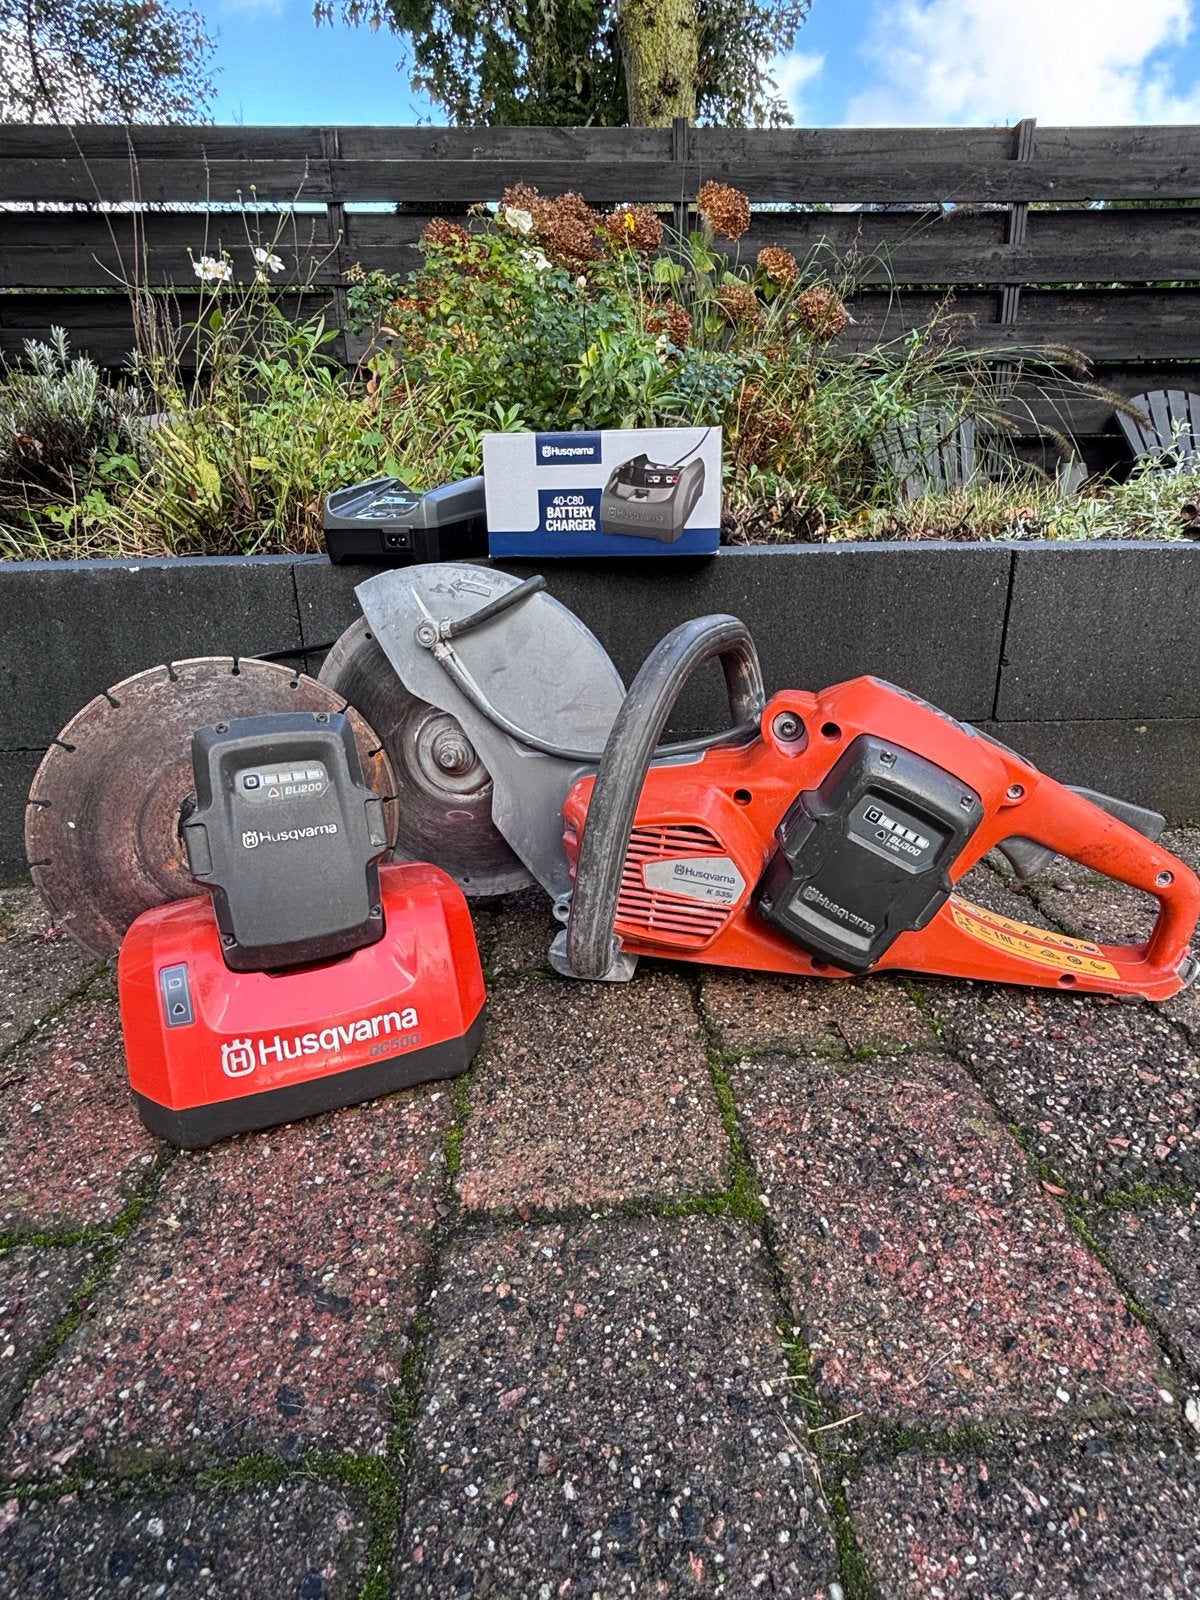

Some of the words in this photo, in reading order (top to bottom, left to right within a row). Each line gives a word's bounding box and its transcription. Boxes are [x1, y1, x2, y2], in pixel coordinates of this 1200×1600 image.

[551, 447, 594, 456] Husqvarna
[553, 496, 584, 505] 40-C80
[547, 506, 594, 518] BATTERY
[546, 519, 596, 531] CHARGER
[260, 823, 338, 842] Husqvarna
[685, 866, 736, 884] Husqvarna
[706, 888, 714, 896] K
[815, 893, 876, 934] Husqvarna
[258, 1007, 419, 1066] Husqvarna
[368, 1032, 420, 1057] QC500
